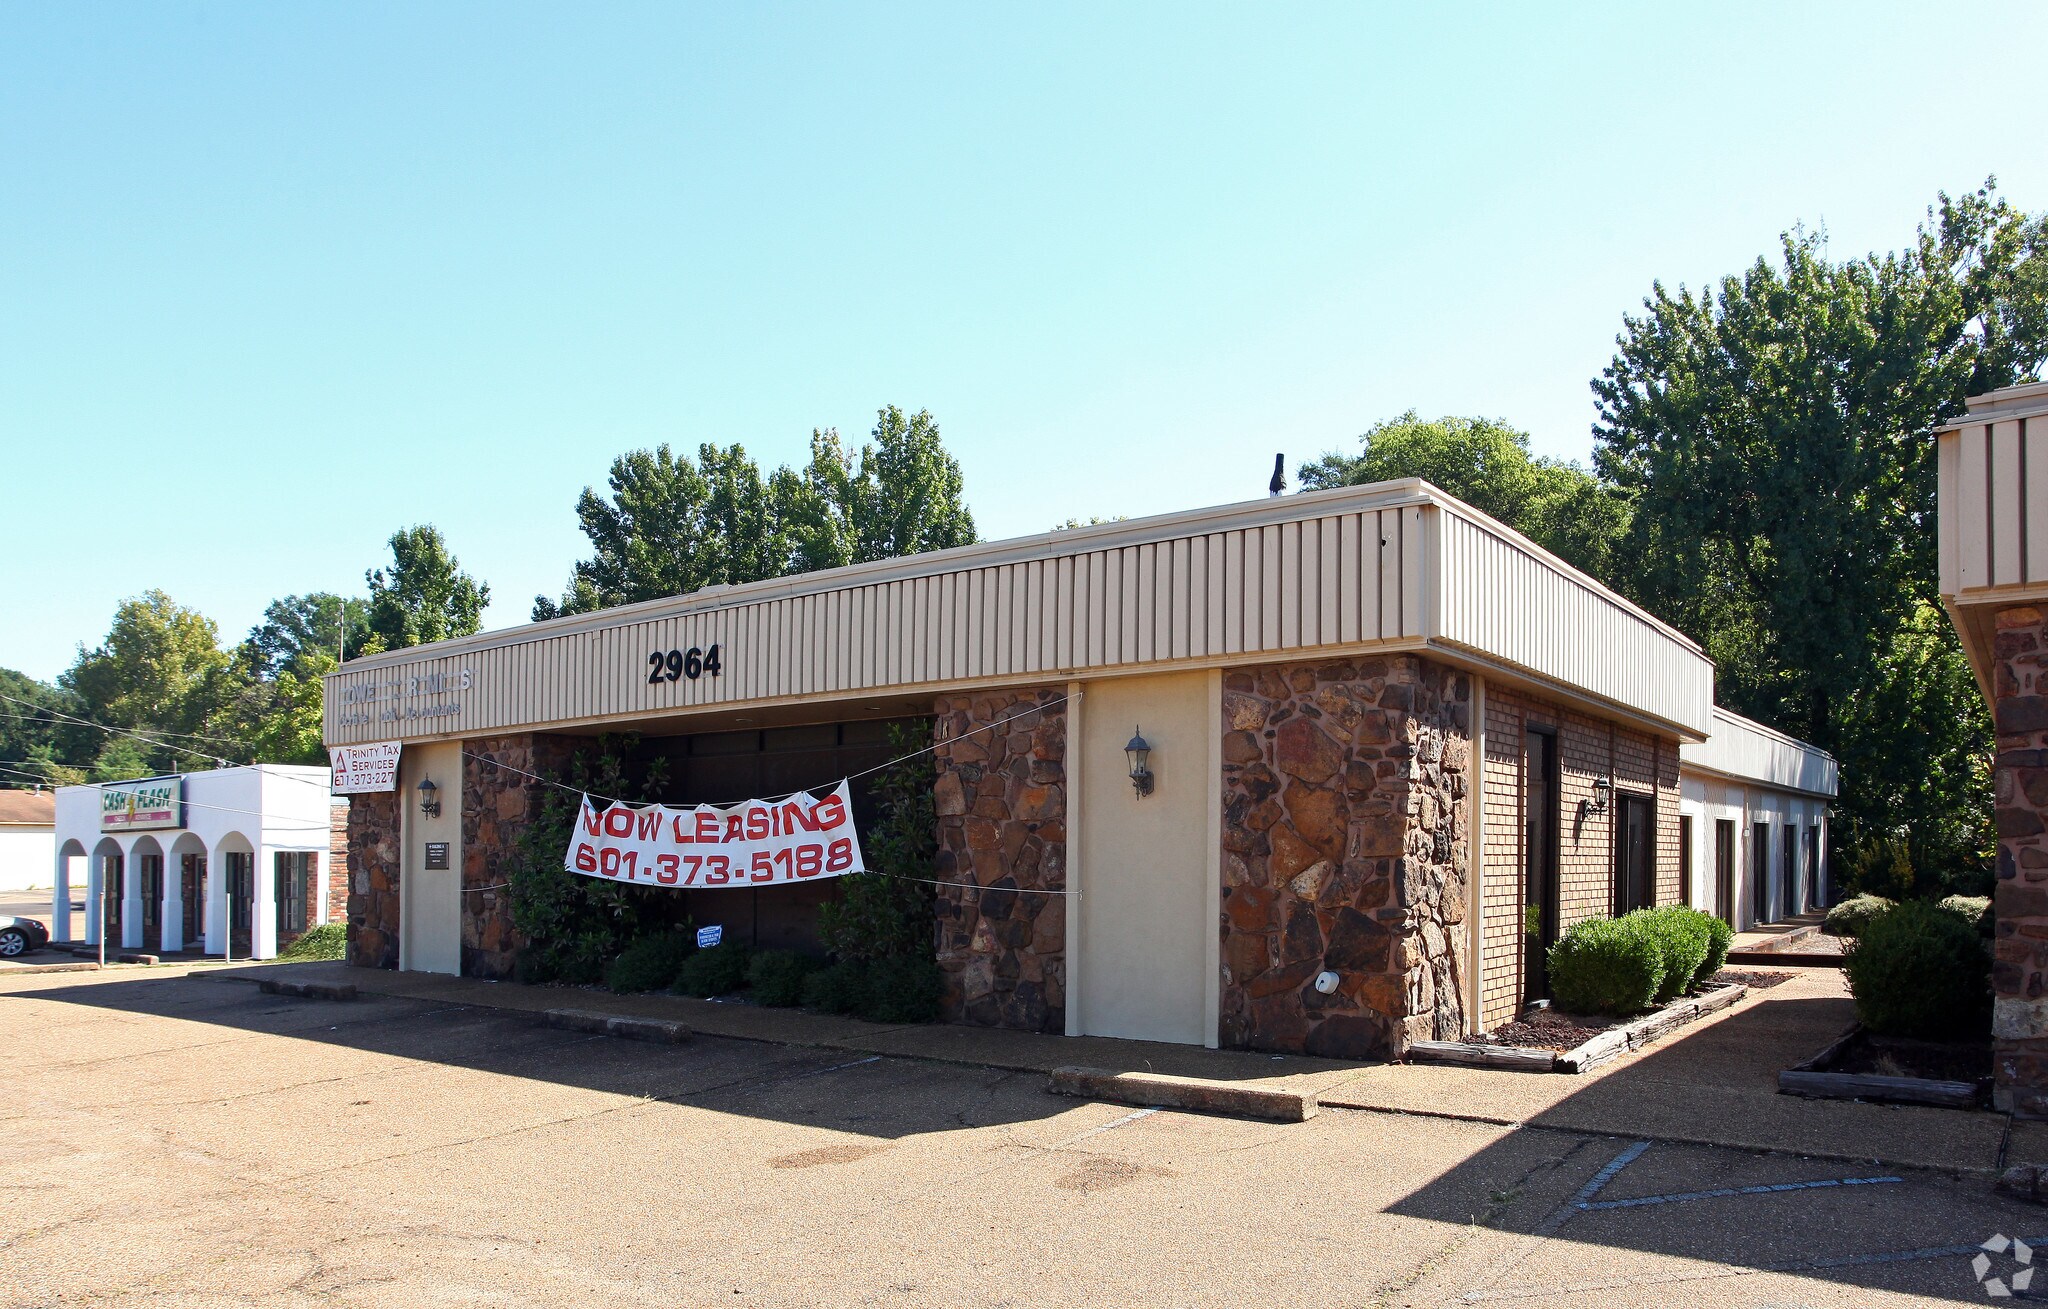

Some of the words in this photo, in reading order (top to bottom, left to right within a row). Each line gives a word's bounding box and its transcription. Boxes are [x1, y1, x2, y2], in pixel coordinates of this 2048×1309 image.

[649, 644, 721, 684] 2964
[104, 791, 126, 811] CASH
[137, 787, 171, 809] FLASH
[583, 803, 662, 842] NOW
[673, 794, 847, 844] LEASING
